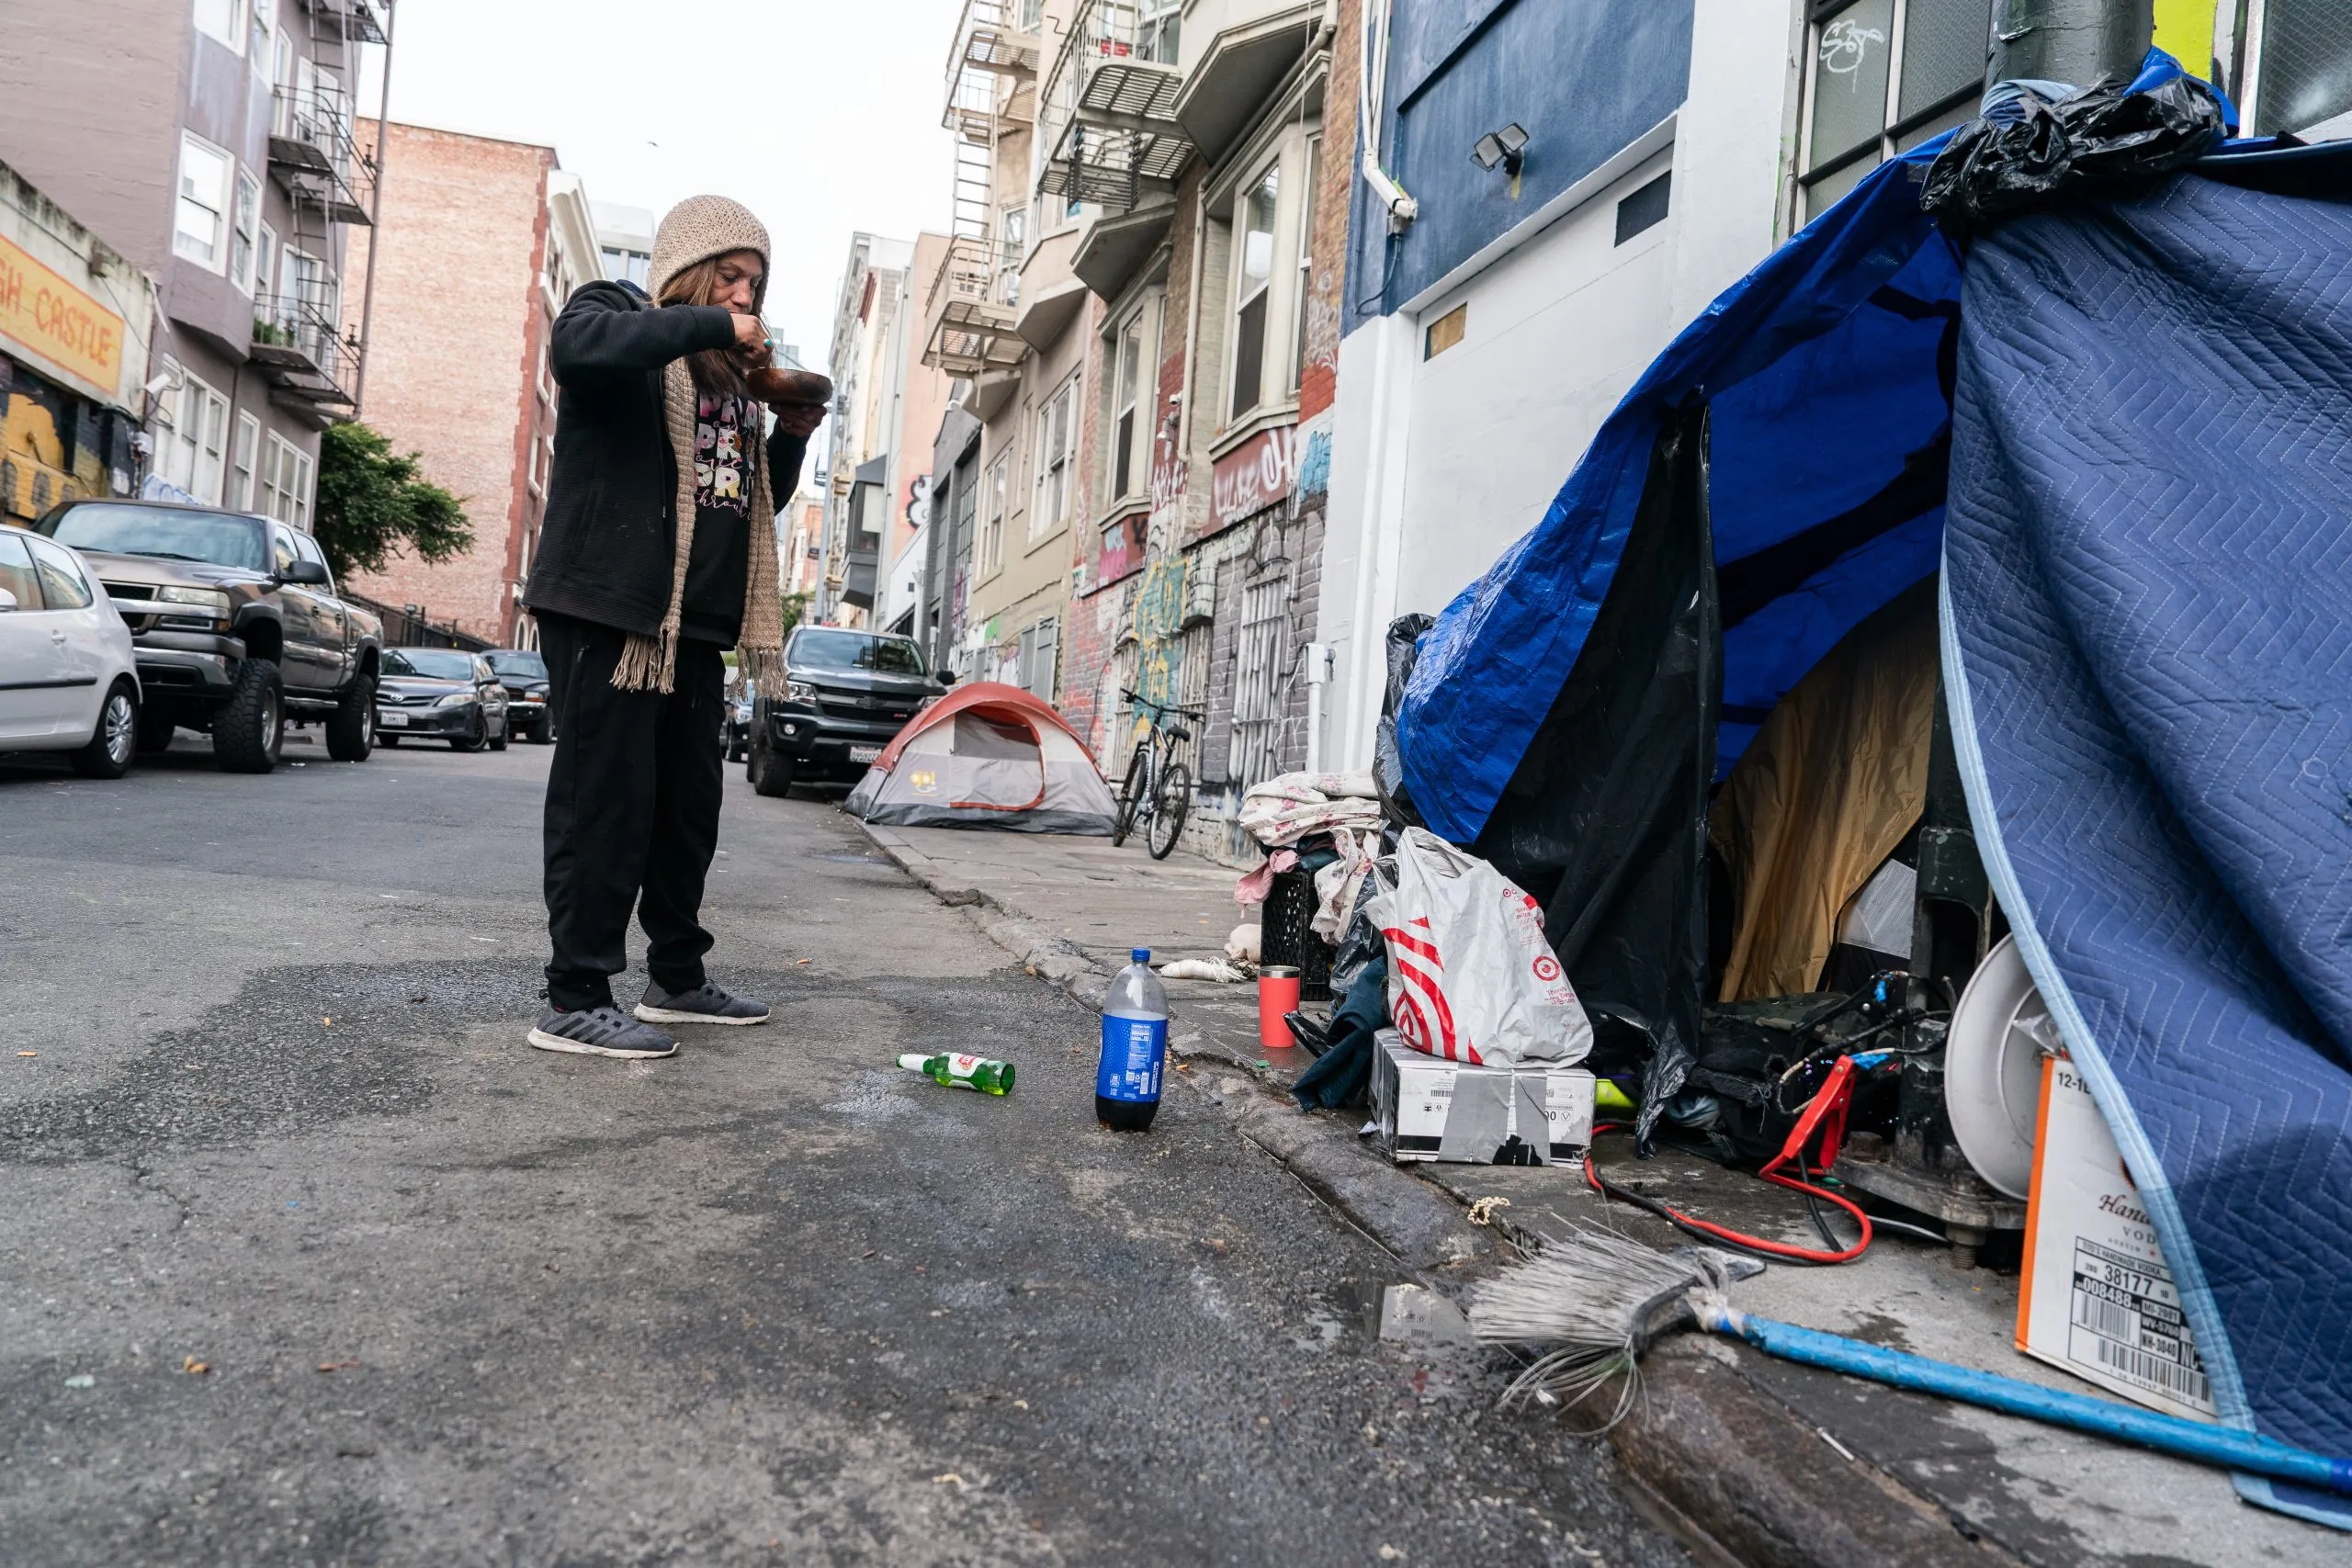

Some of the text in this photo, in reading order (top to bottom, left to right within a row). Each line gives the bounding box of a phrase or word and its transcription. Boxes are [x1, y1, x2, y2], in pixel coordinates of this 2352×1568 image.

[35, 286, 112, 368] CASTLE
[2122, 1225, 2156, 1244] VOD
[2105, 1265, 2153, 1295] 38177
